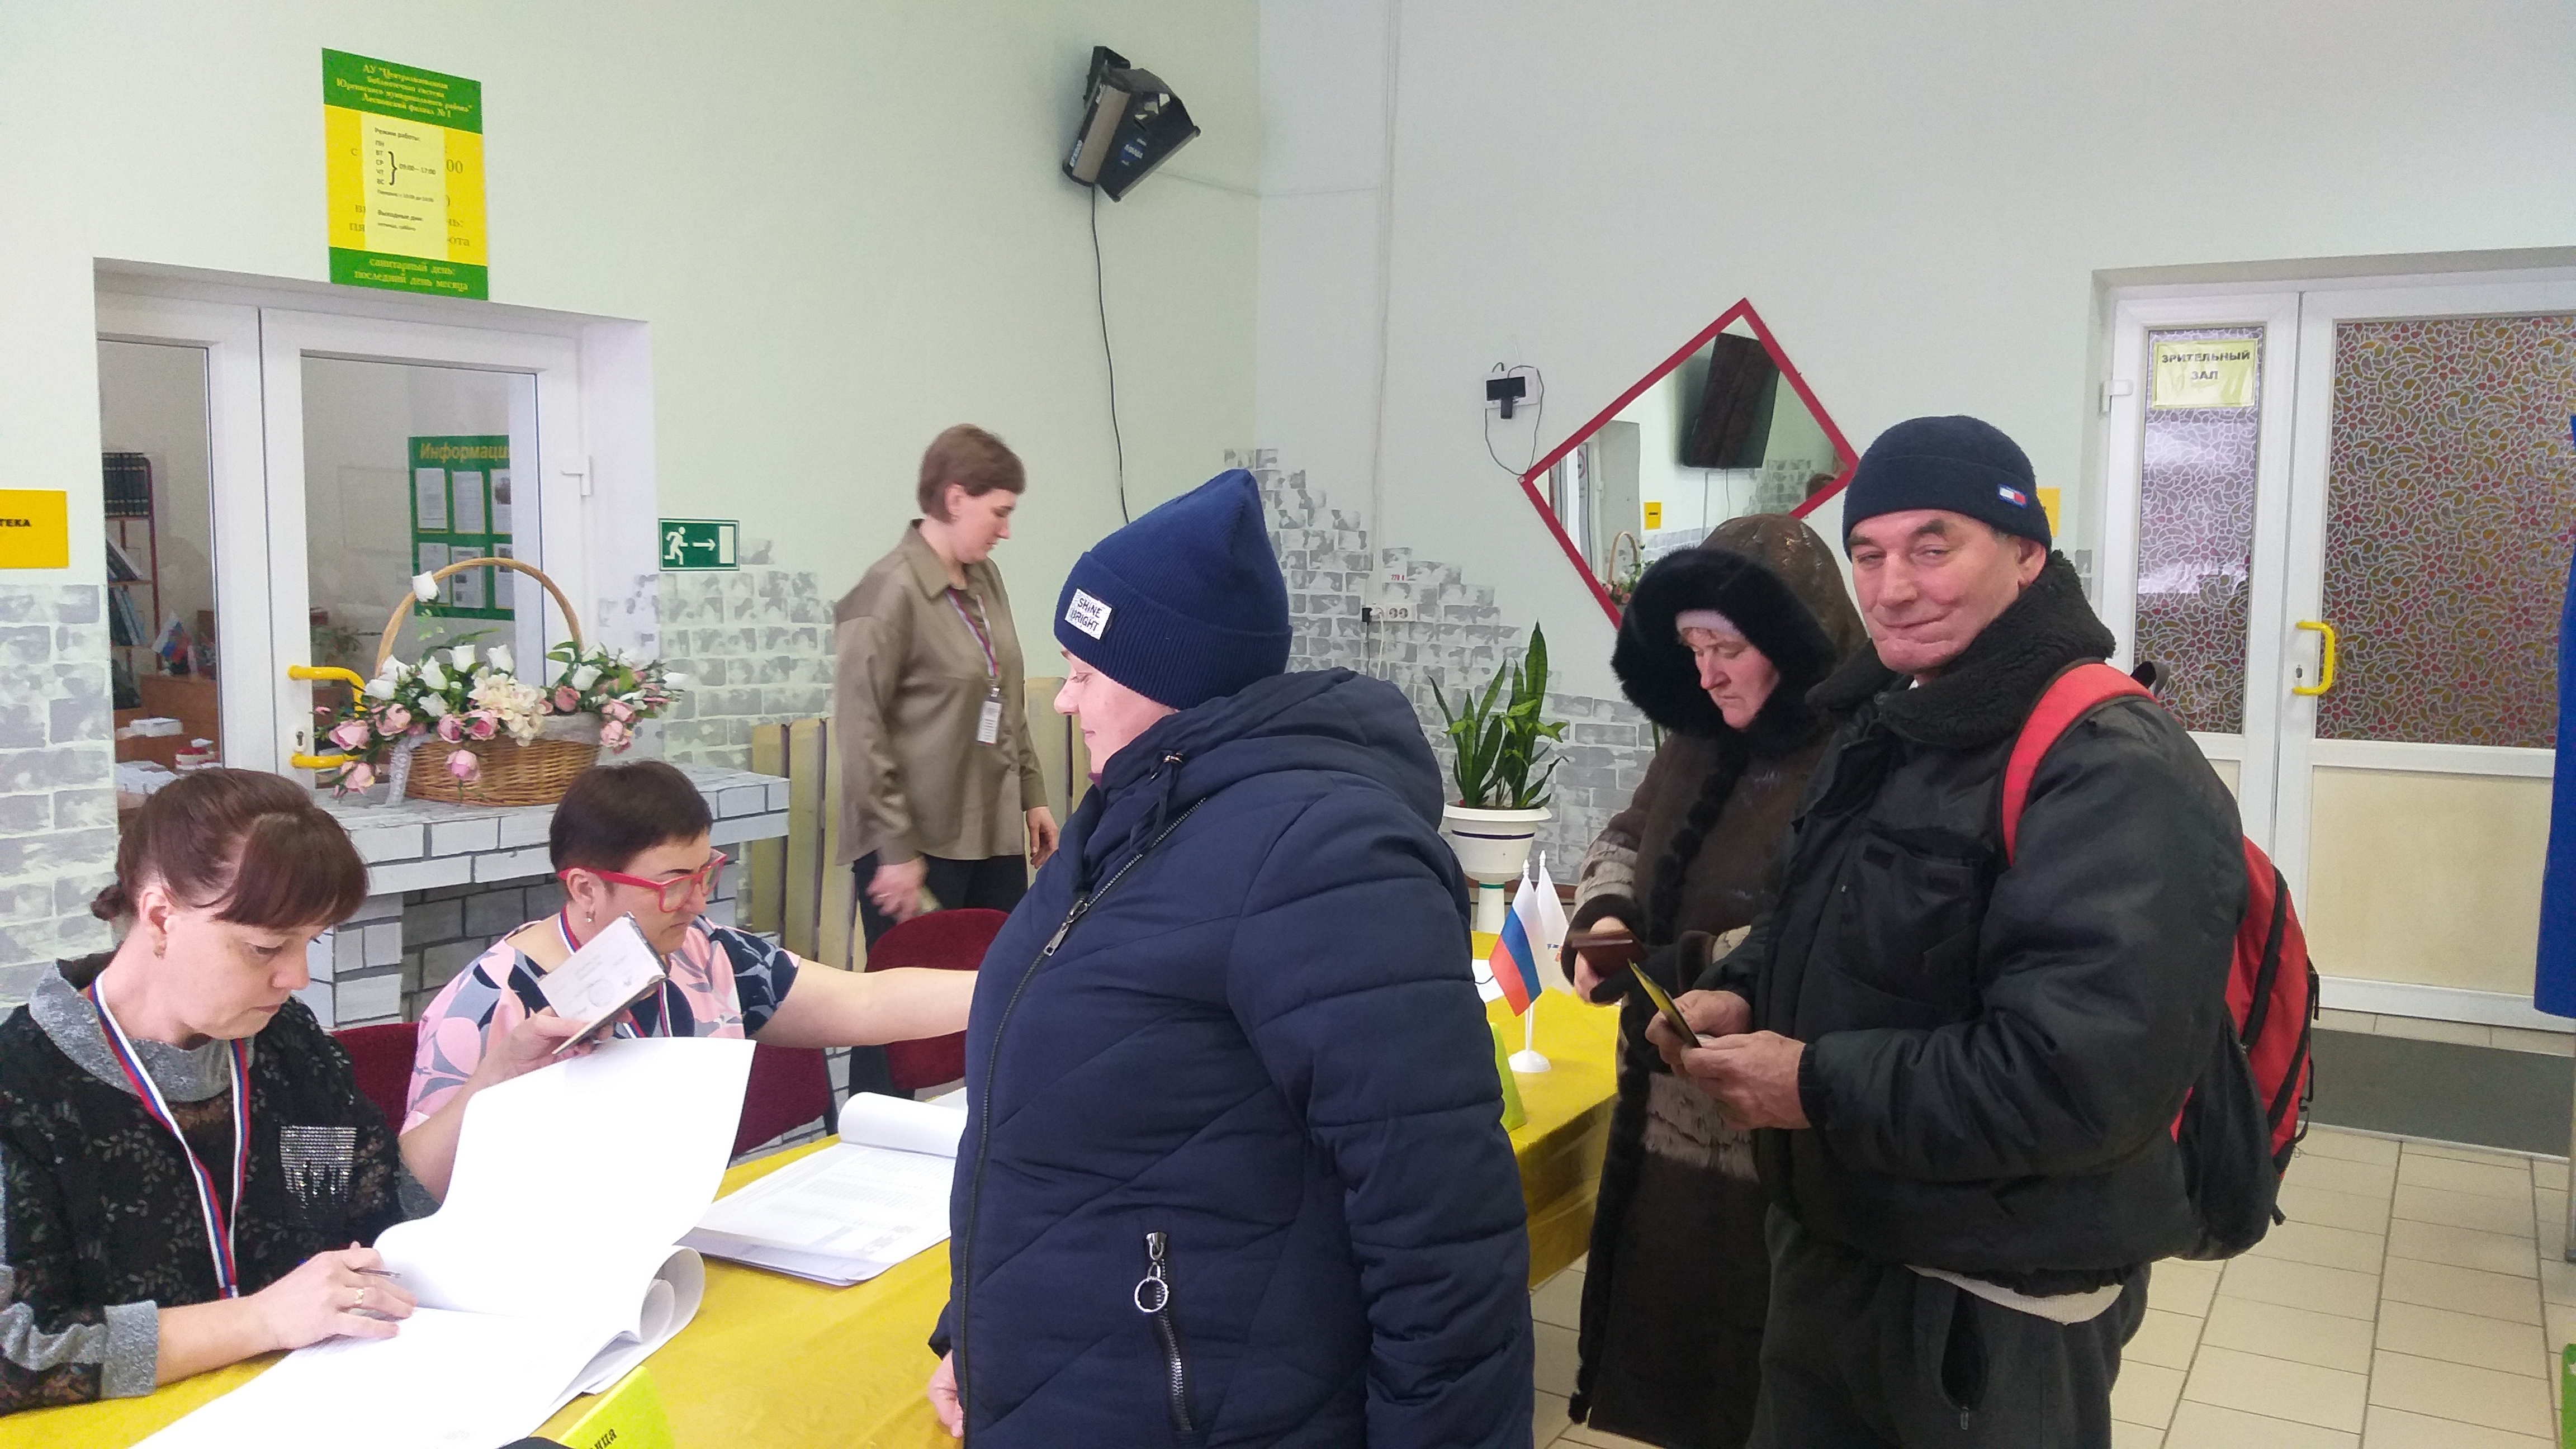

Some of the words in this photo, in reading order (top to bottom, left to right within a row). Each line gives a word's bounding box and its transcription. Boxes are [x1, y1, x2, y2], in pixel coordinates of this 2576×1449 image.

[2161, 349, 2251, 363] ЗРИТЕЛЬНЫЙ
[2191, 370, 2219, 380] ЗАЛ
[420, 442, 510, 463] Информаци
[1077, 598, 1102, 618] SHINE
[1071, 609, 1100, 632] BRIGHT
